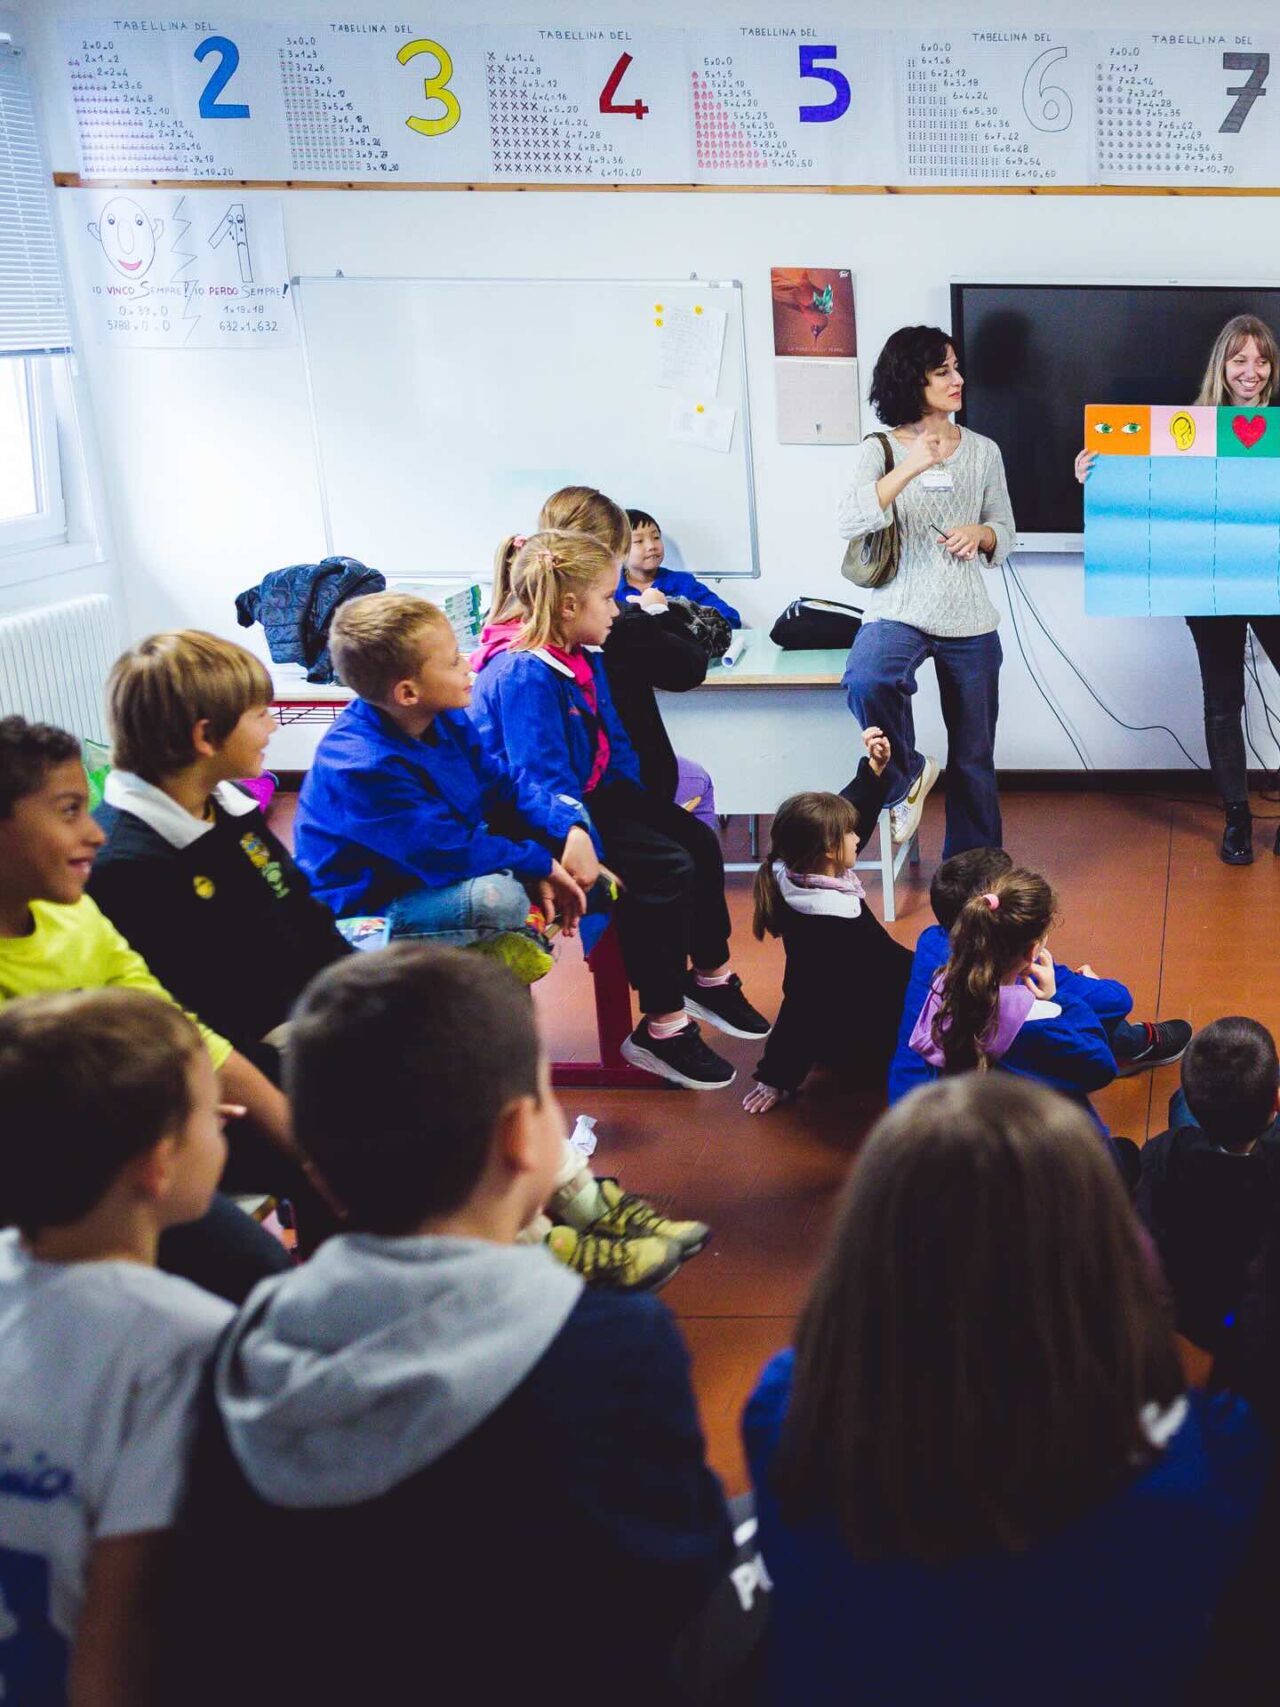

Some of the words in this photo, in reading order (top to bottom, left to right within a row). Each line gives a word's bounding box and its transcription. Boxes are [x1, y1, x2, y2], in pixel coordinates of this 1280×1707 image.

[114, 21, 188, 31] TABELLINA
[194, 22, 217, 31] DEL
[330, 24, 387, 33] TABELLINA
[395, 25, 413, 33] DEL
[539, 30, 604, 40] TABELLINA
[610, 31, 632, 40] DEL
[740, 27, 796, 37] TABELLINA
[801, 28, 817, 37] DEL
[973, 33, 1027, 42] TABELLINA
[1035, 33, 1052, 42] DEL
[1152, 35, 1225, 44] TABELLINA
[1235, 36, 1252, 45] DEL
[194, 36, 250, 118] 2
[396, 38, 461, 136] 3
[599, 52, 649, 120] 4
[799, 45, 851, 123] 5
[1022, 46, 1072, 133] 6
[1218, 52, 1270, 133] 7
[107, 287, 135, 295] VINCO
[209, 287, 239, 295] PERDO
